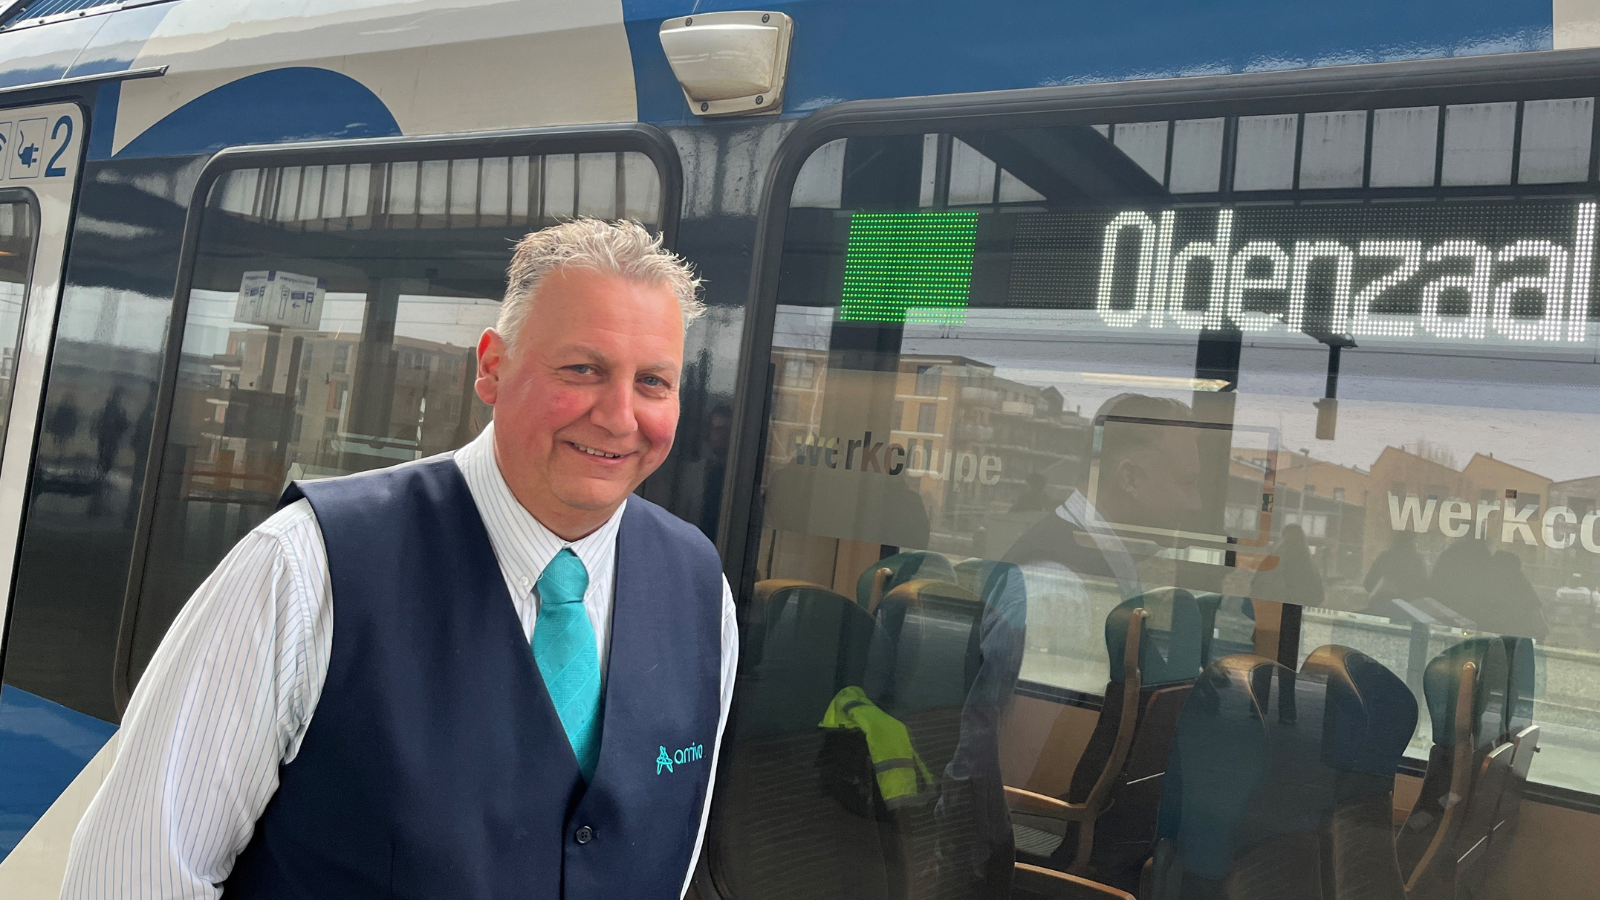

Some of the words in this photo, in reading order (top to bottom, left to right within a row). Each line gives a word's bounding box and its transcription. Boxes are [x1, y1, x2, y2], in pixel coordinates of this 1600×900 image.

[44, 115, 73, 177] 2
[1097, 202, 1597, 342] Oldenzaal
[795, 431, 1002, 493] werkcoupe
[674, 741, 703, 765] arriva
